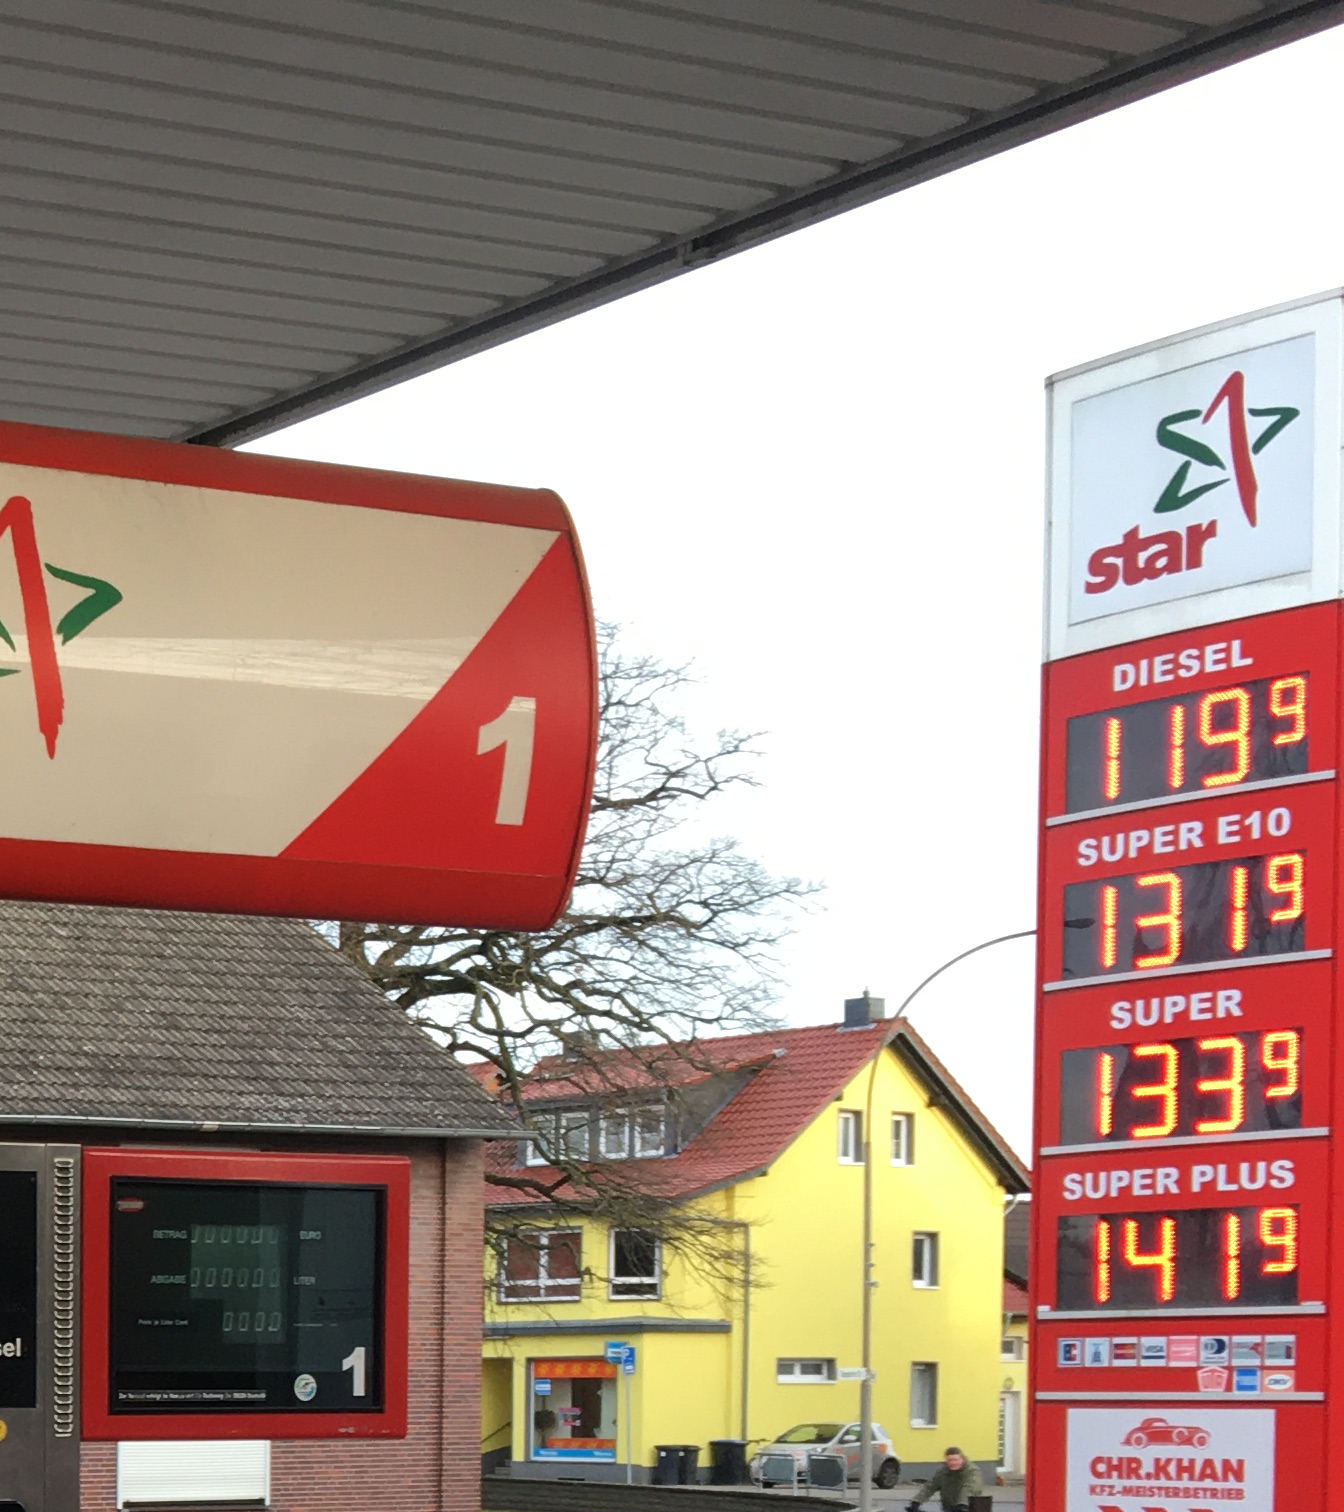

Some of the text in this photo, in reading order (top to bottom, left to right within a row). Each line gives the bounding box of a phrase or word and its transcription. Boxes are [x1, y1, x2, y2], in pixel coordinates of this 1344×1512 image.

[1084, 519, 1217, 595] star
[1113, 639, 1254, 692] DIESEL
[476, 695, 538, 826] 1
[1077, 807, 1292, 867] SUPER E10
[1109, 988, 1244, 1030] SUPER
[1063, 1159, 1296, 1201] SUPER PLUS
[342, 1346, 366, 1397] 1
[1088, 1483, 1246, 1501] KFZ-MEISTERBETRIEB
